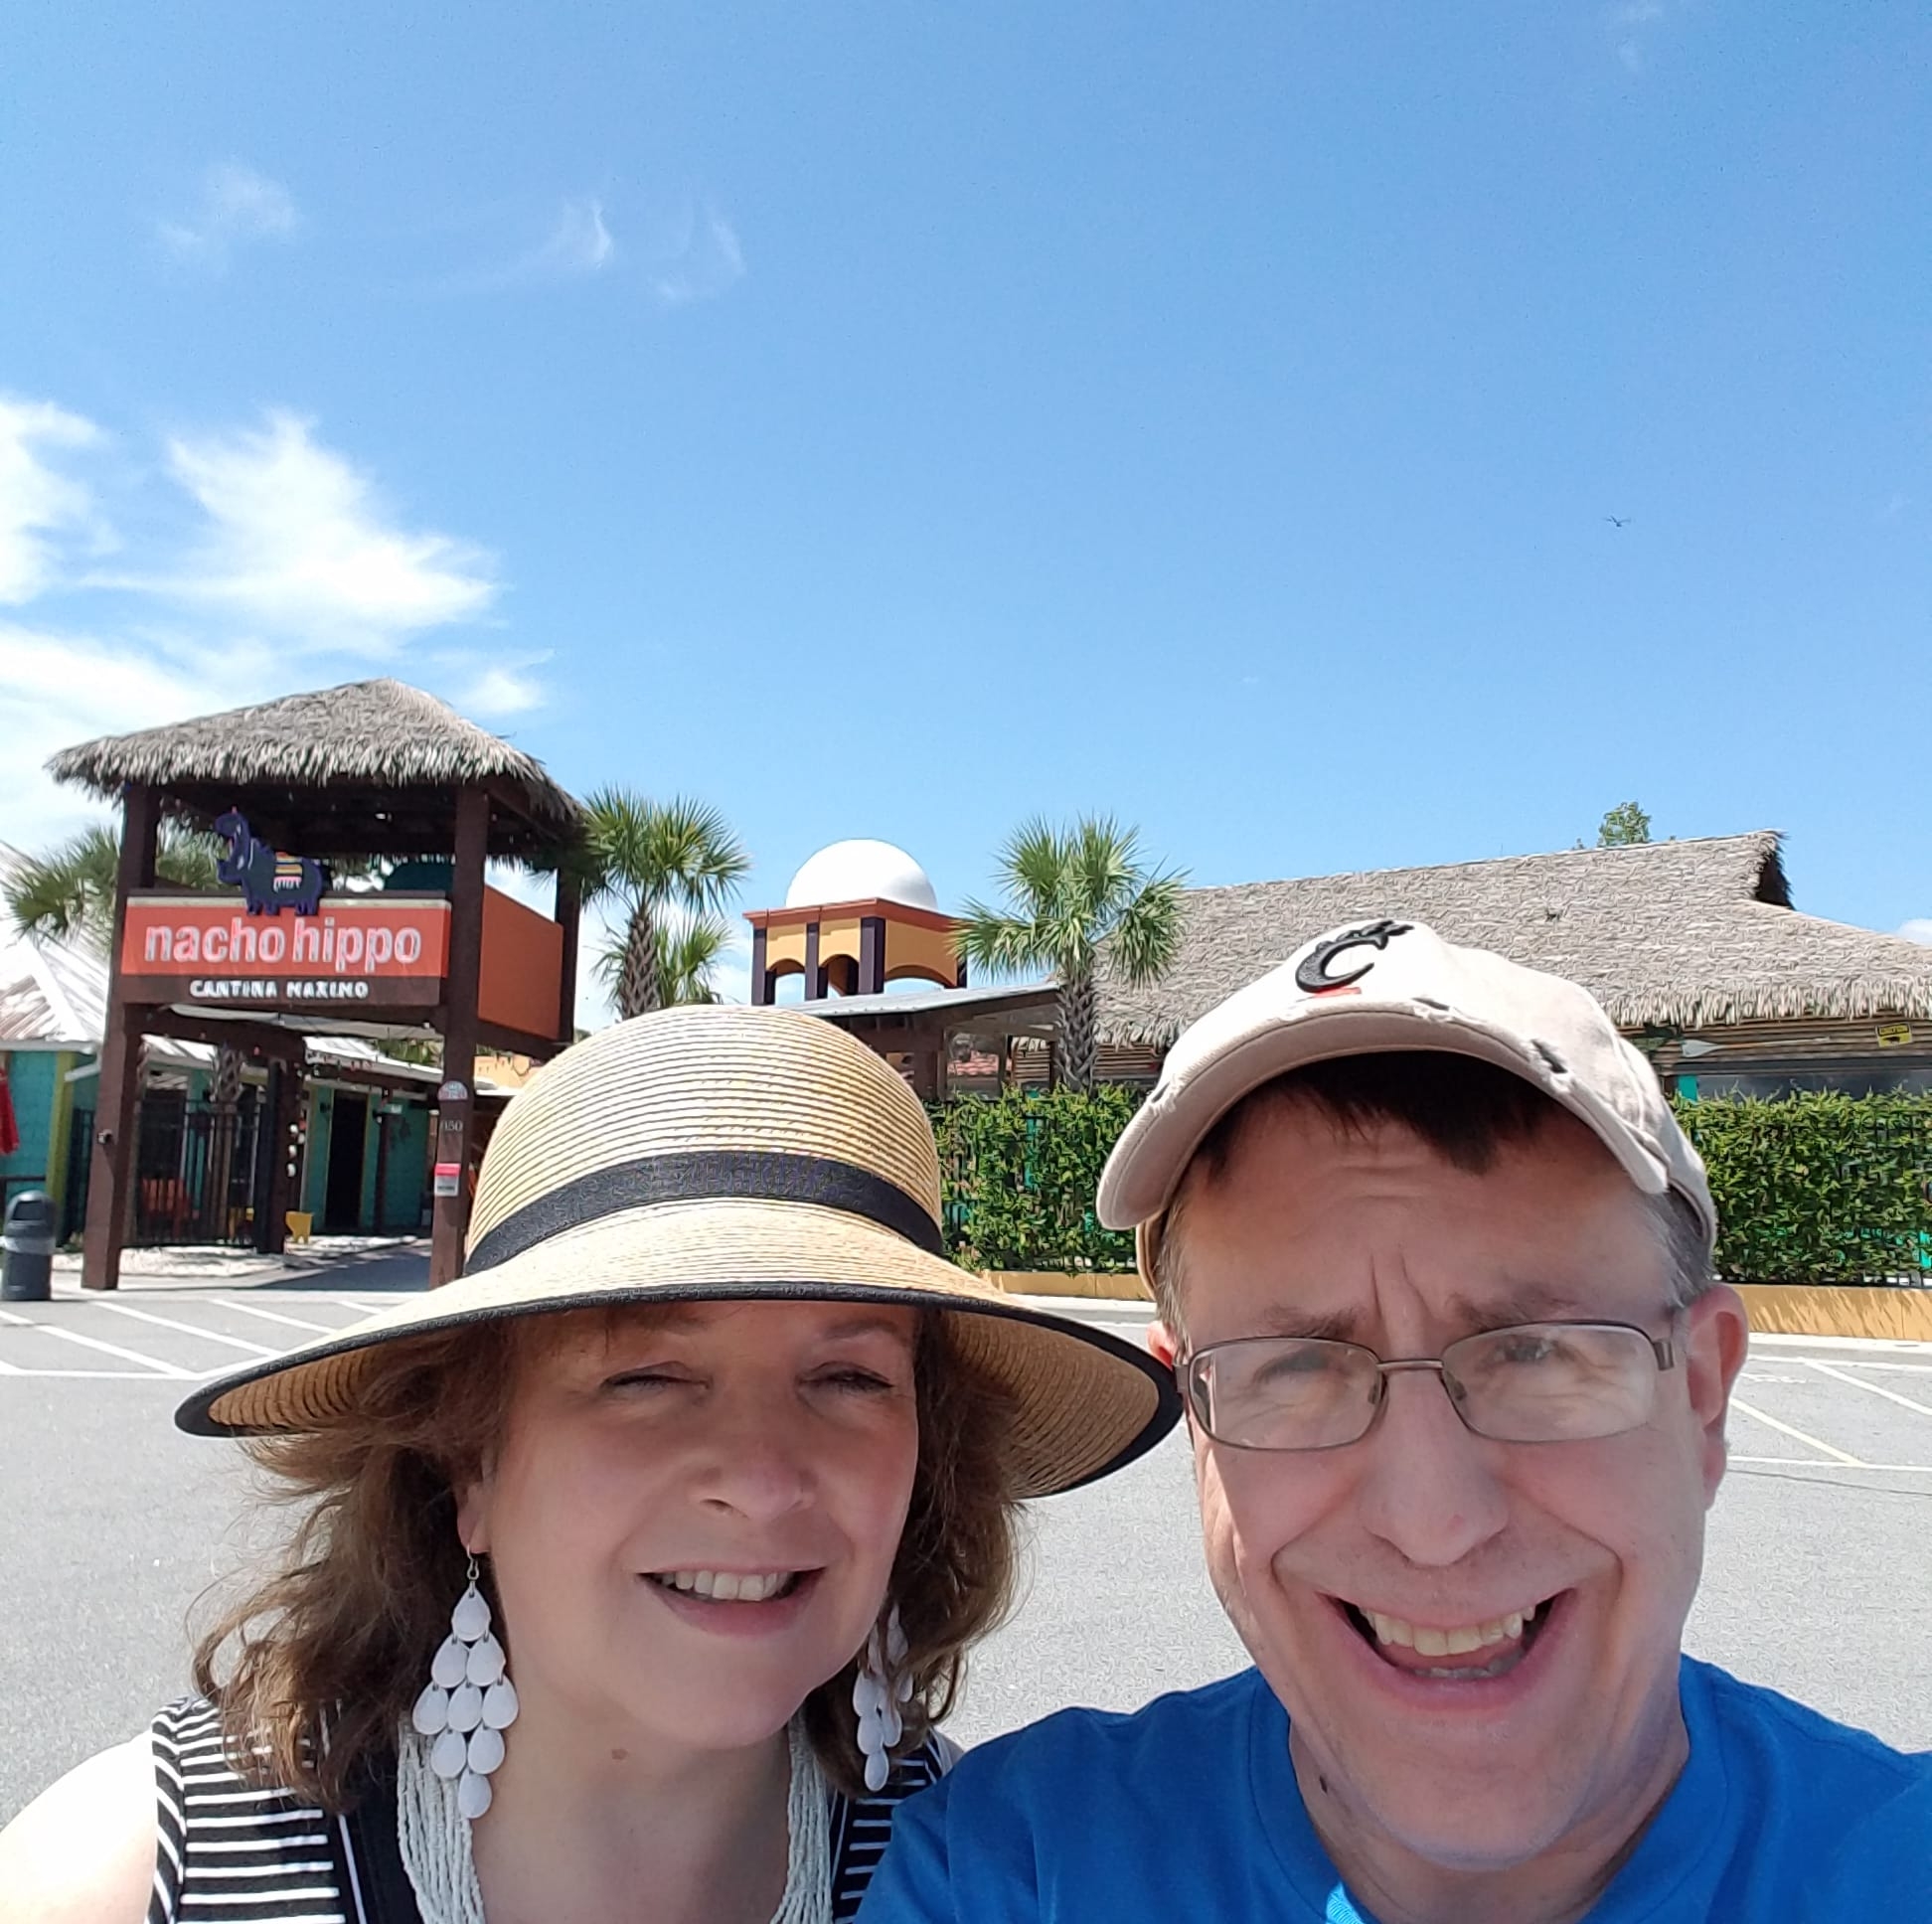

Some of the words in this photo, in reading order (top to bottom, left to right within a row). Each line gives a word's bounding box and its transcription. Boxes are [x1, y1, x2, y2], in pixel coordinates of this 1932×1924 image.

[144, 916, 285, 964] nacho
[292, 917, 421, 974] hippo
[1295, 919, 1414, 994] C
[189, 980, 277, 1000] CANTINA
